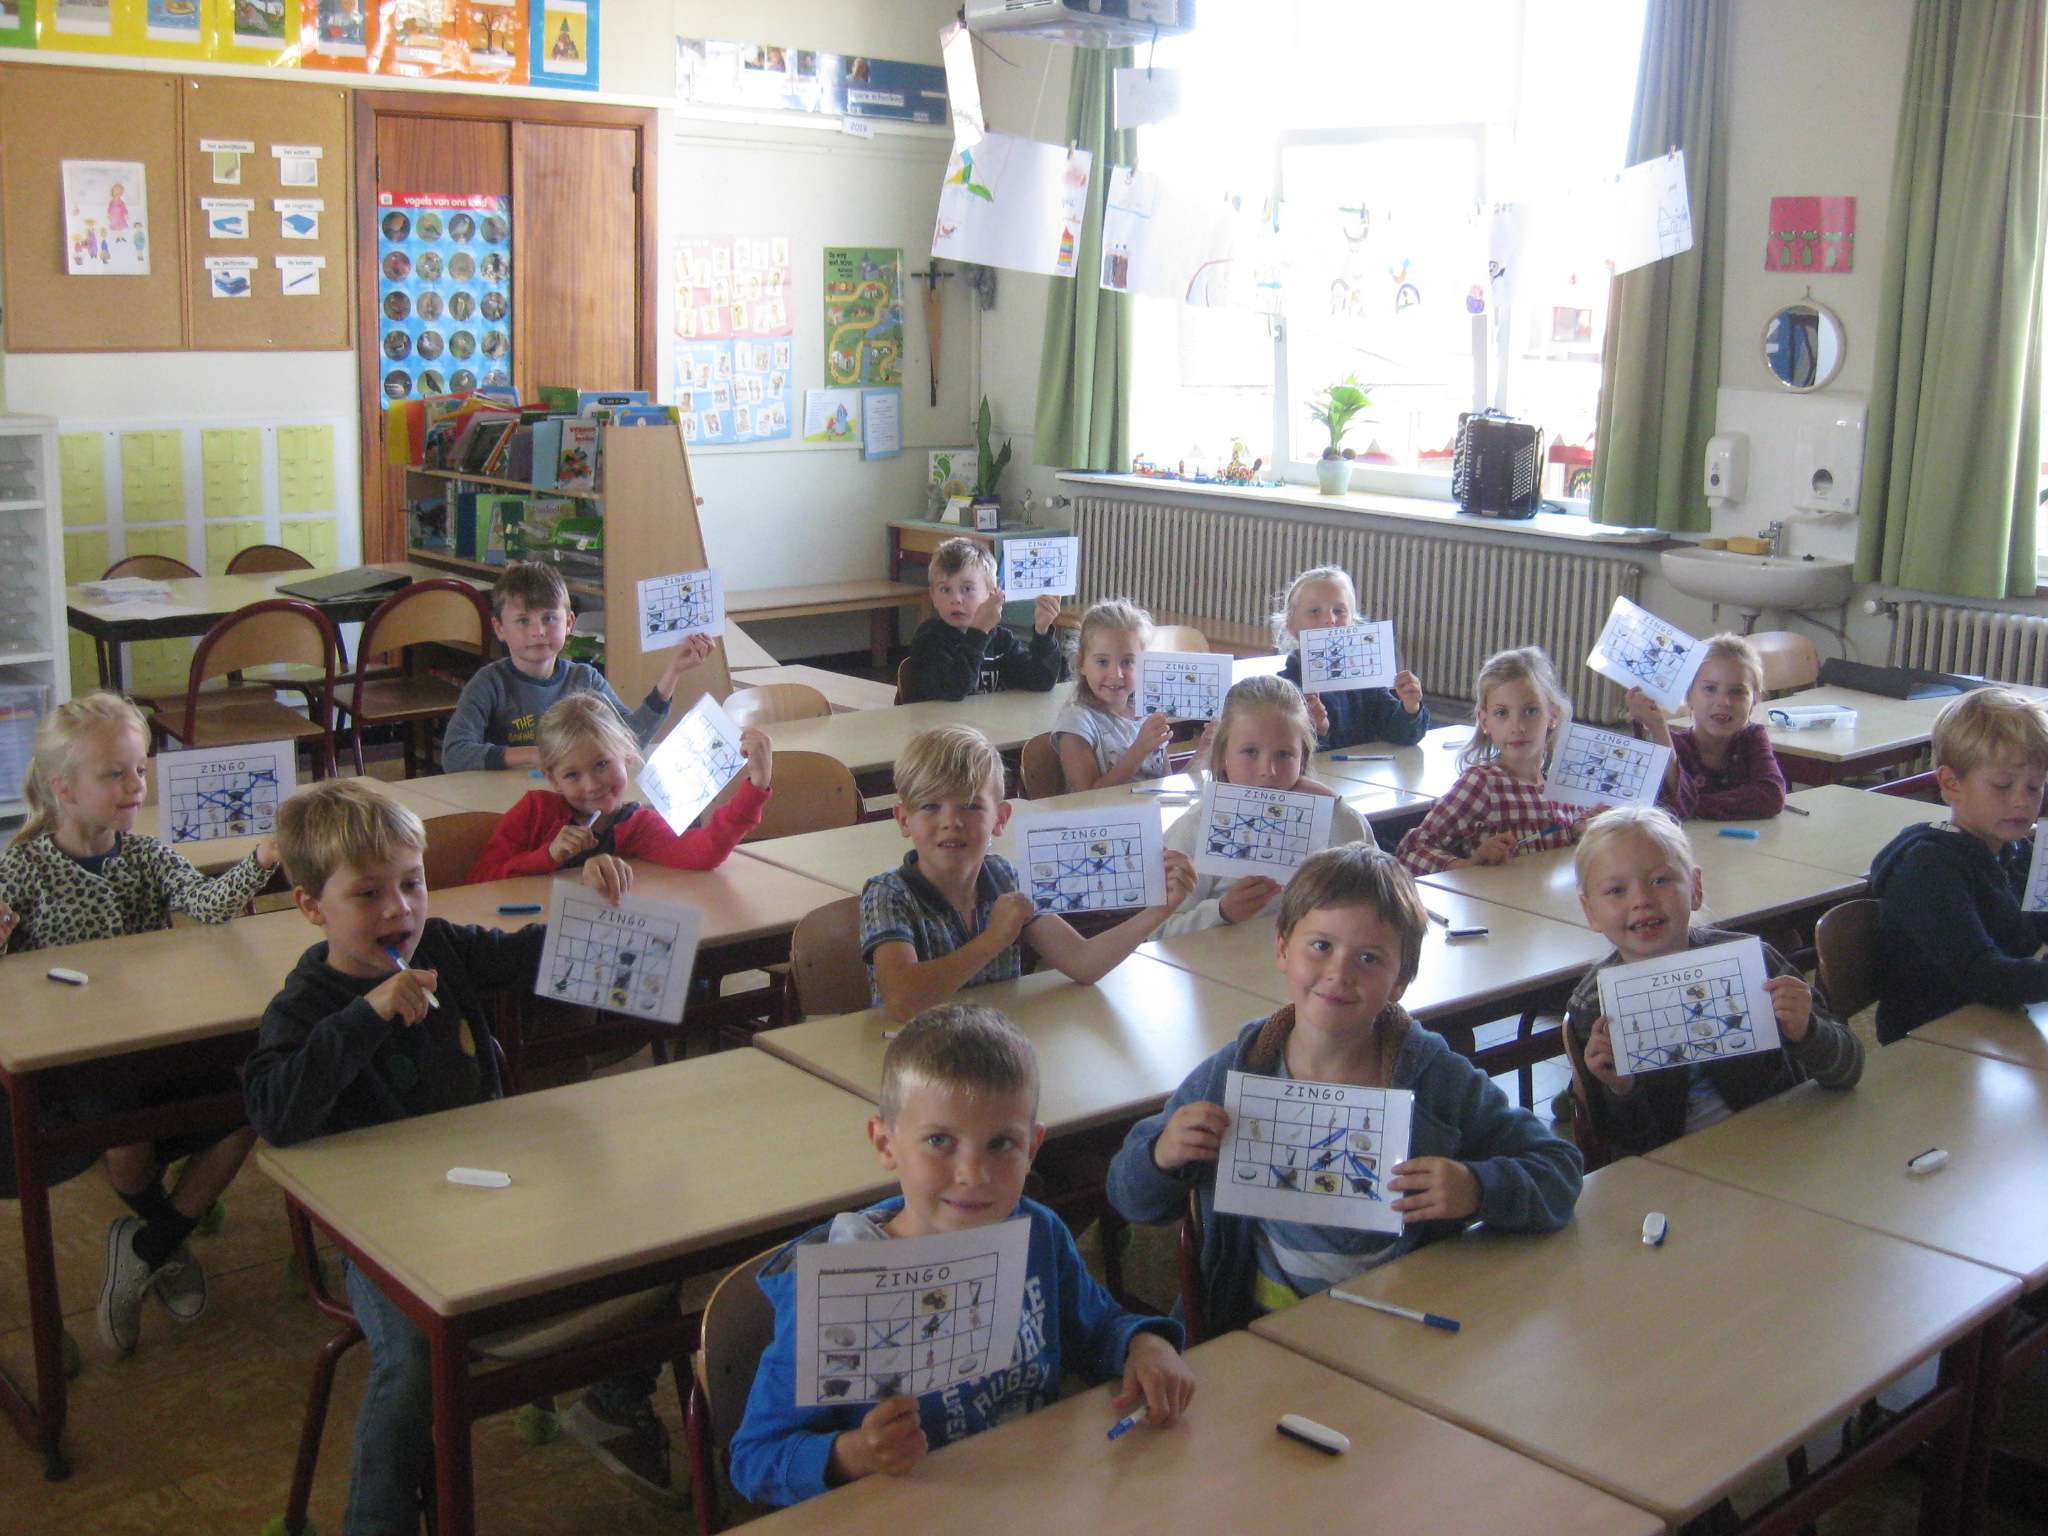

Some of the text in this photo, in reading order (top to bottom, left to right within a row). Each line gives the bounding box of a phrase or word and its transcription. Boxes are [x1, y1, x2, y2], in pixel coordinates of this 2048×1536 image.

[404, 196, 432, 208] vogels
[434, 198, 450, 207] van
[452, 199, 467, 207] ons
[1643, 615, 1673, 636] ZINGO
[1165, 663, 1198, 671] ZINGO
[511, 714, 534, 730] THE
[1594, 732, 1631, 746] ZINGO
[201, 761, 246, 774] ZINGO
[1244, 789, 1286, 801] ZINGO
[1060, 828, 1108, 841] ZINGO
[599, 909, 648, 928] ZINGO
[1652, 968, 1703, 987] ZINGO
[1283, 1084, 1345, 1102] ZINGO
[875, 1266, 951, 1288] ZINGO
[966, 1361, 1051, 1420] RUGBY
